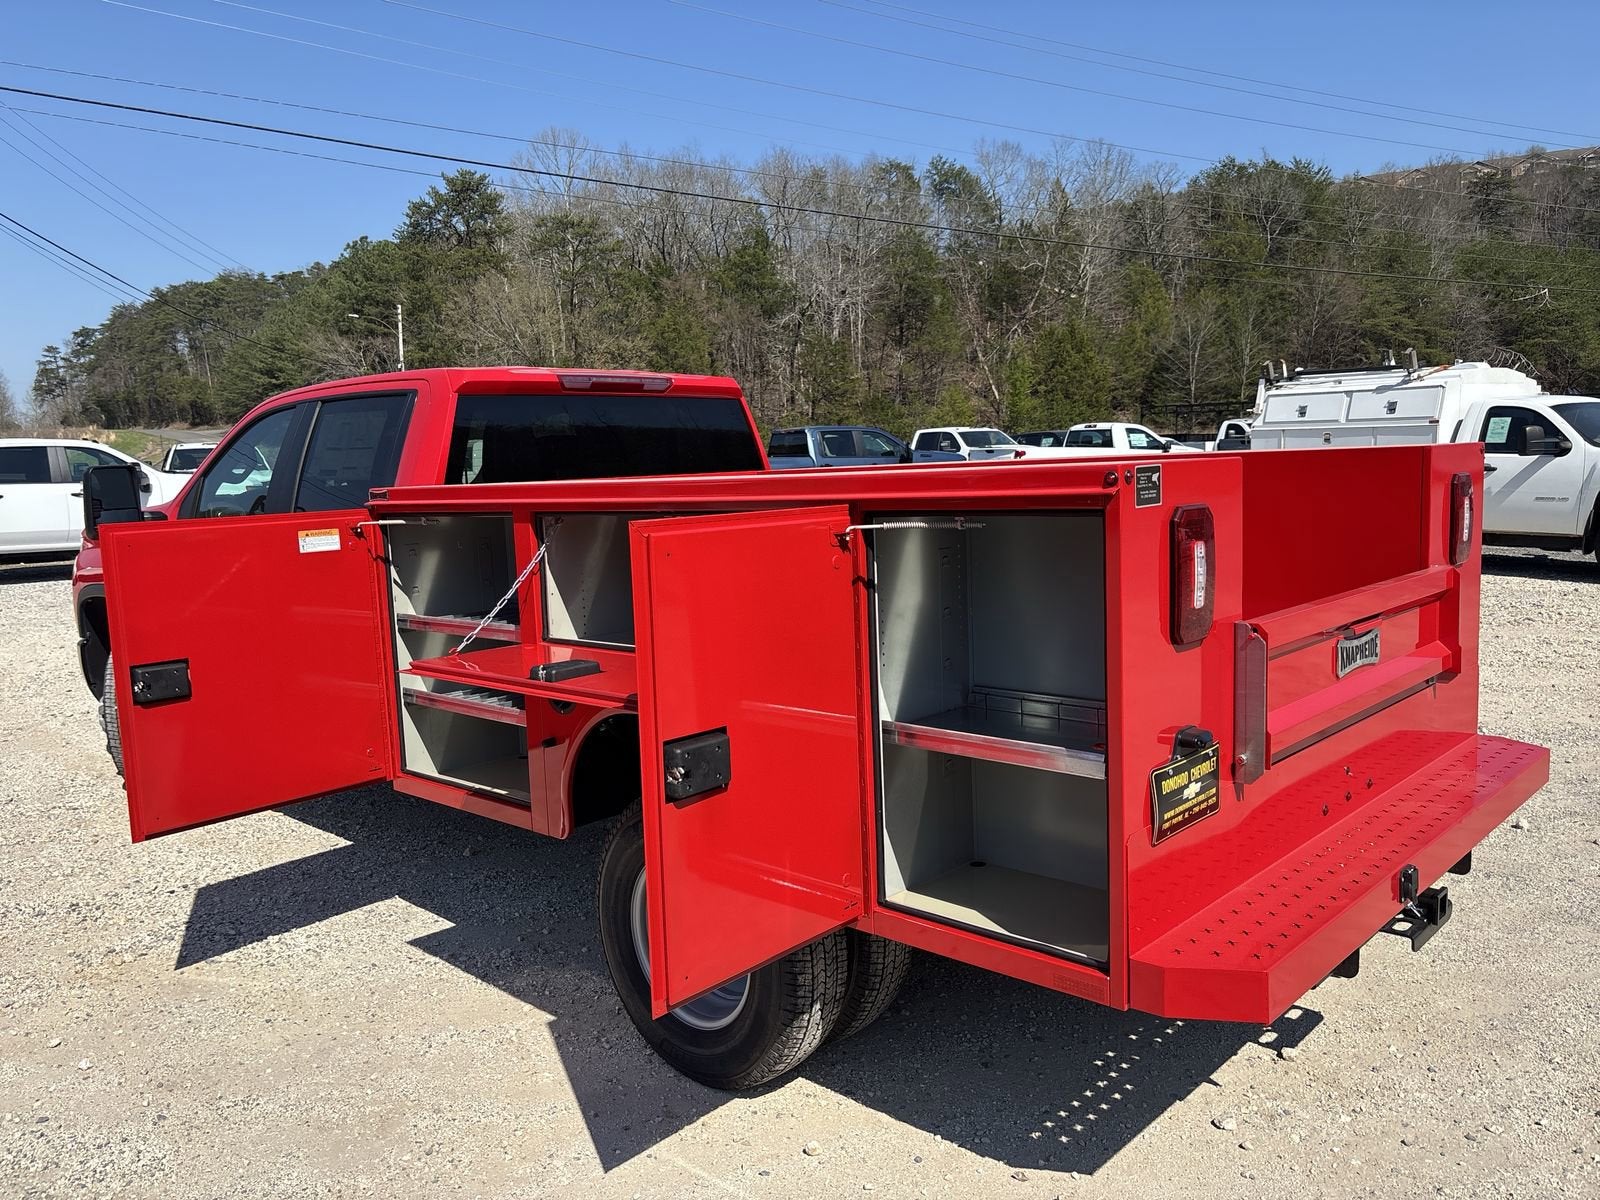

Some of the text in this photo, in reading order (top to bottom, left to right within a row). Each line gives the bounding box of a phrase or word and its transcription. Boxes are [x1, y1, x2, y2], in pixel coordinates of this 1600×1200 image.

[1340, 633, 1379, 672] KNAPHEIDE
[1161, 756, 1217, 795] DONOHOO CHEVROLET
